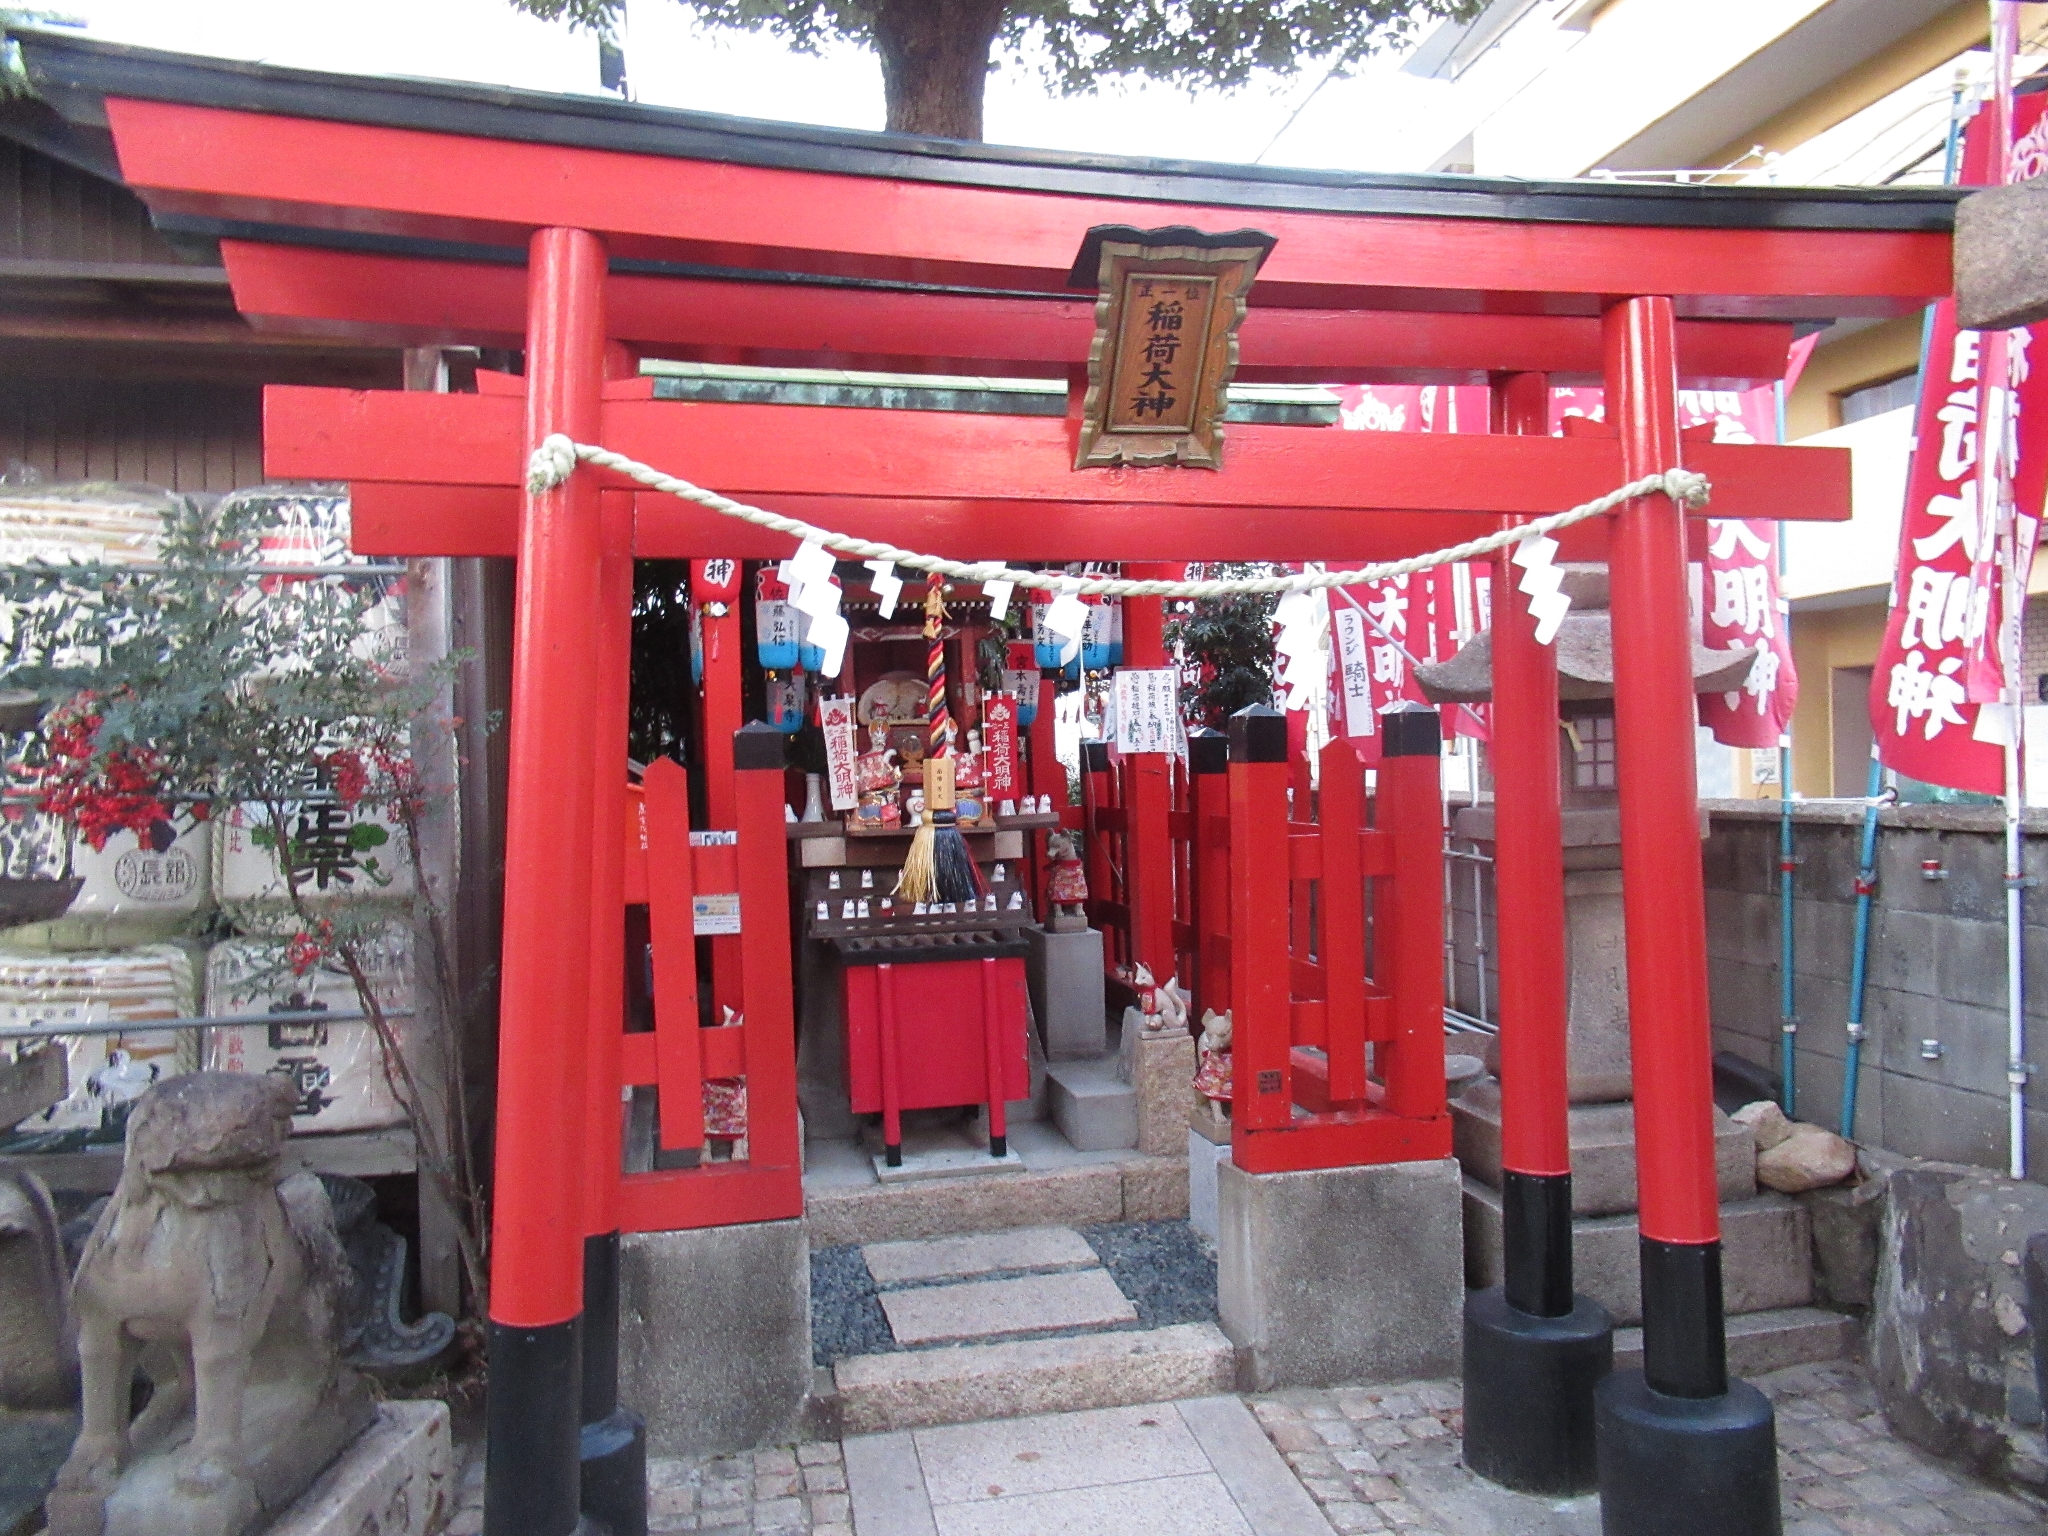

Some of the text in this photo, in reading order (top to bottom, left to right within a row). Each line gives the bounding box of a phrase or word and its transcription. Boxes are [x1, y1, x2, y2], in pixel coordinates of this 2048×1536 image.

[1138, 284, 1201, 300] 正一位
[1128, 300, 1185, 419] 稲荷大神
[1343, 614, 1366, 698] ラウンジ 騎士
[830, 736, 854, 799] 稲荷大明神
[992, 729, 1011, 792] 稲荷大明神
